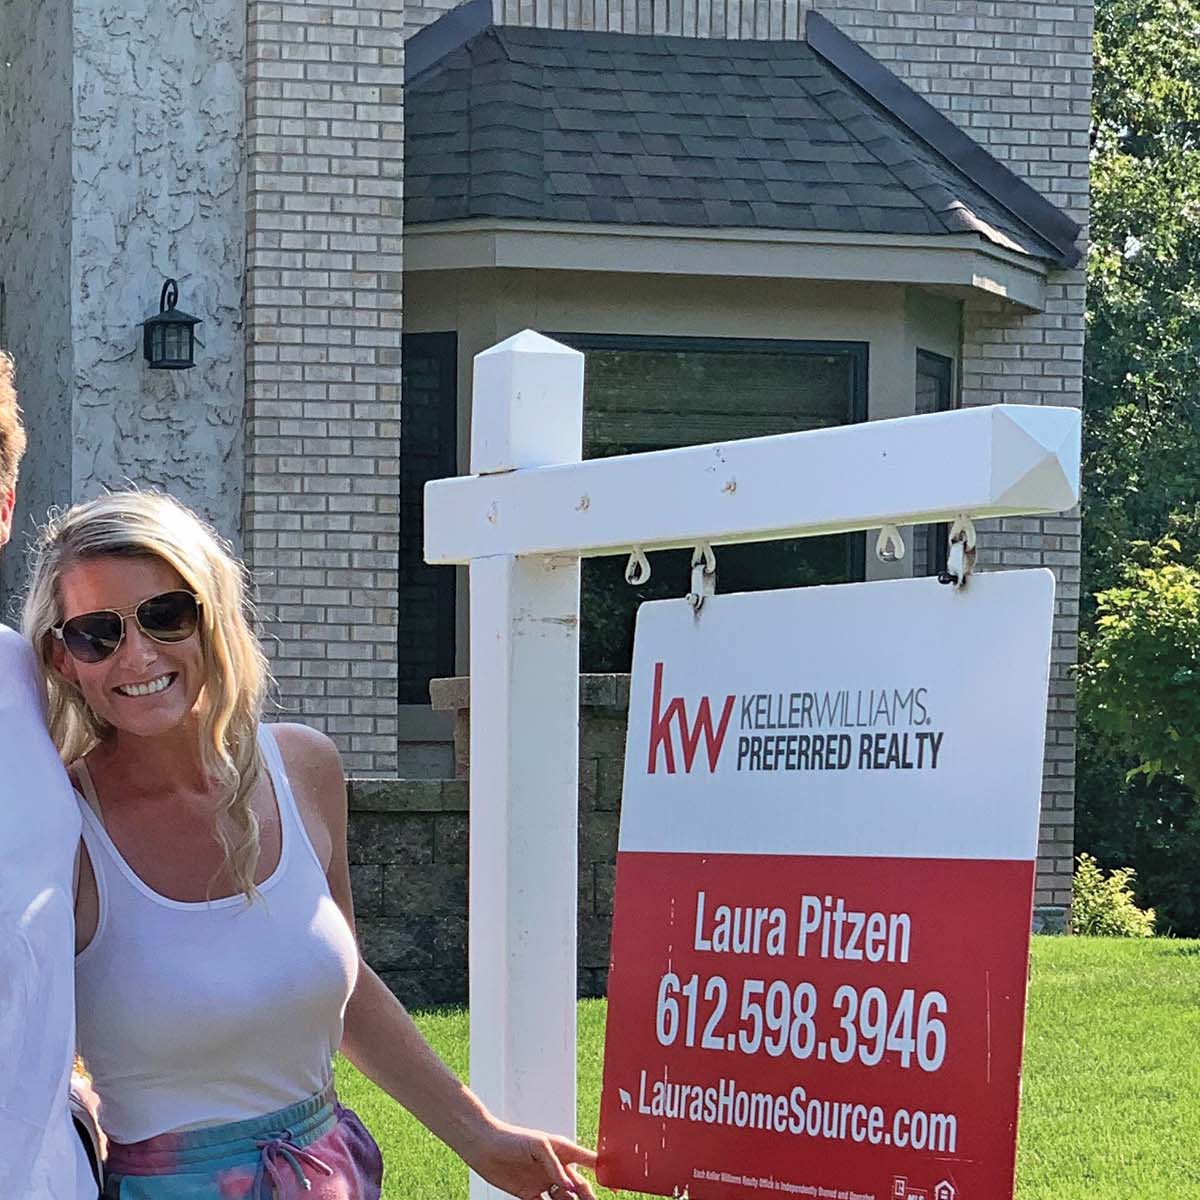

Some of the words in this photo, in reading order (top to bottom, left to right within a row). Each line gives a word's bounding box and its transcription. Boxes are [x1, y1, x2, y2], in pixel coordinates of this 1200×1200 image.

[737, 734, 852, 771] PREFERRED
[858, 731, 944, 770] REALTY
[694, 891, 787, 956] Laura
[798, 895, 911, 963] Pitzen
[656, 973, 948, 1072] 612.598.3946
[639, 1070, 956, 1153] LaurasHomeSource.com
